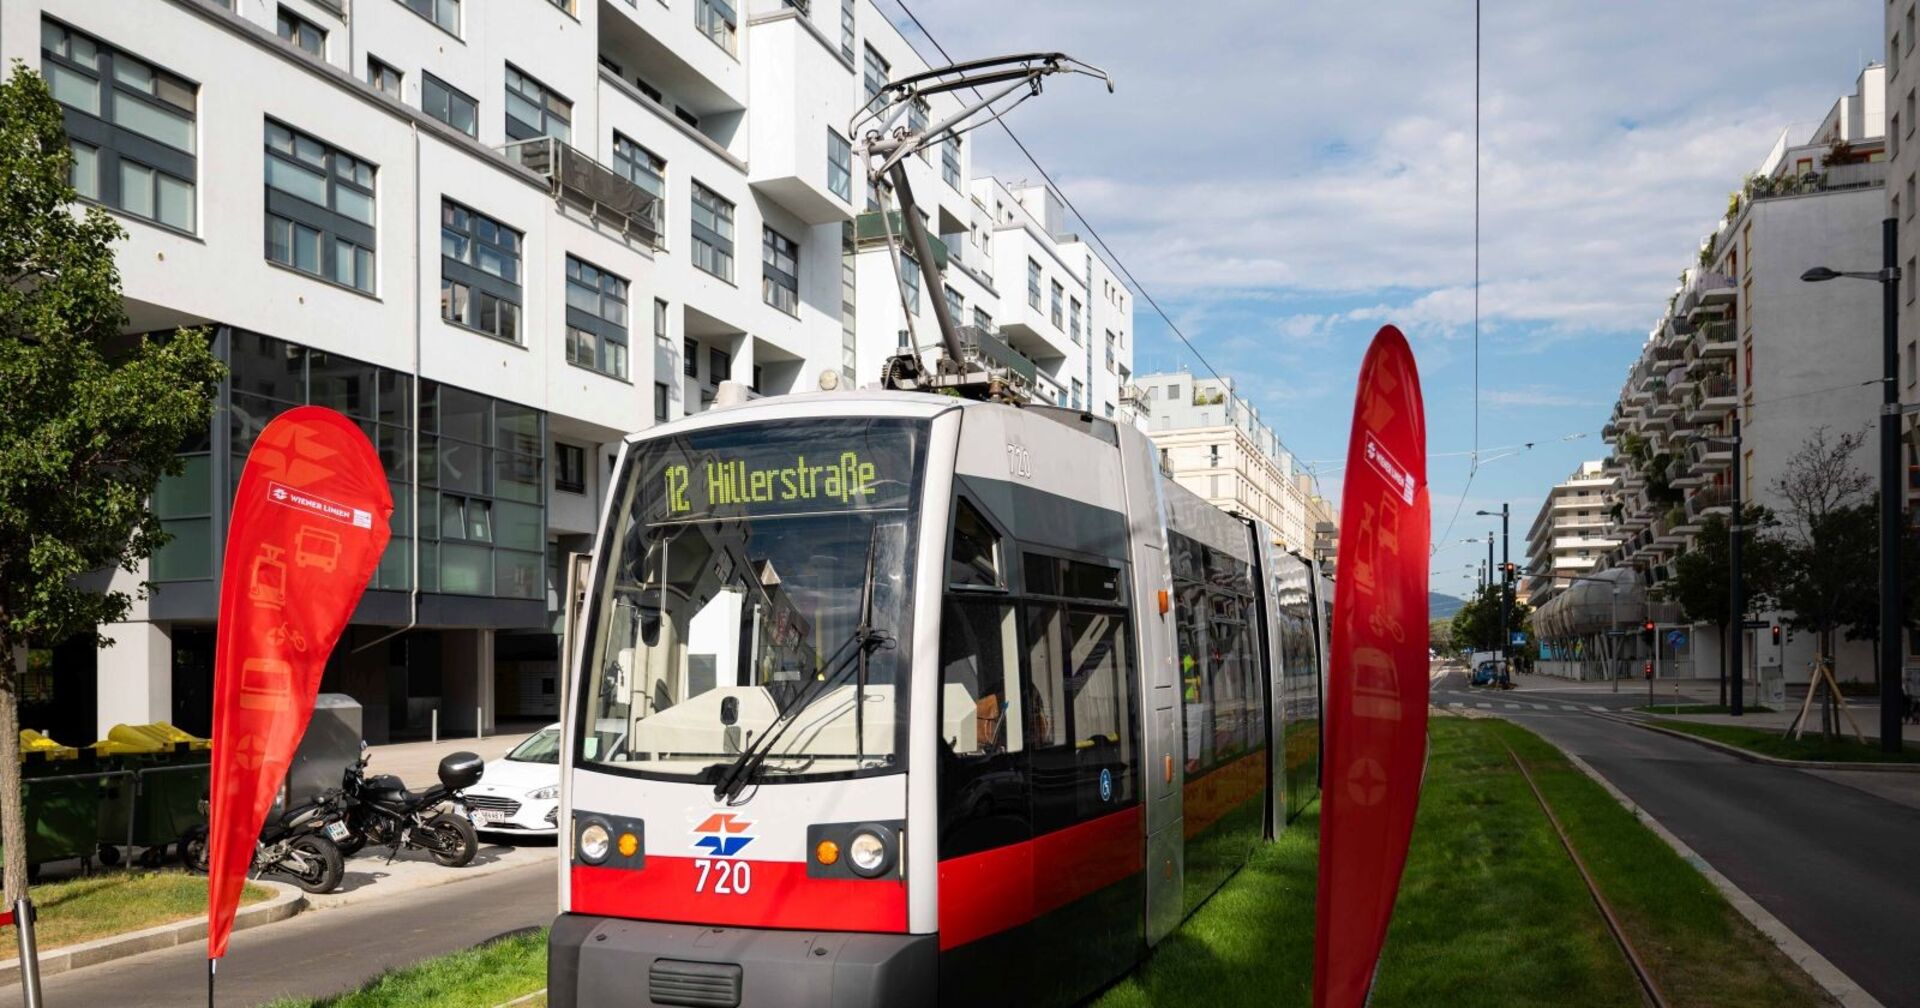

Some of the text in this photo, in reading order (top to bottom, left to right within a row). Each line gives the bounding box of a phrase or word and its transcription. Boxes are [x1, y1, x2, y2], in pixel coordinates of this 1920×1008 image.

[1007, 443, 1031, 479] 720
[665, 451, 876, 512] 12 Hillerstraße
[290, 493, 350, 518] WIENER LINIEN
[695, 859, 751, 895] 720
